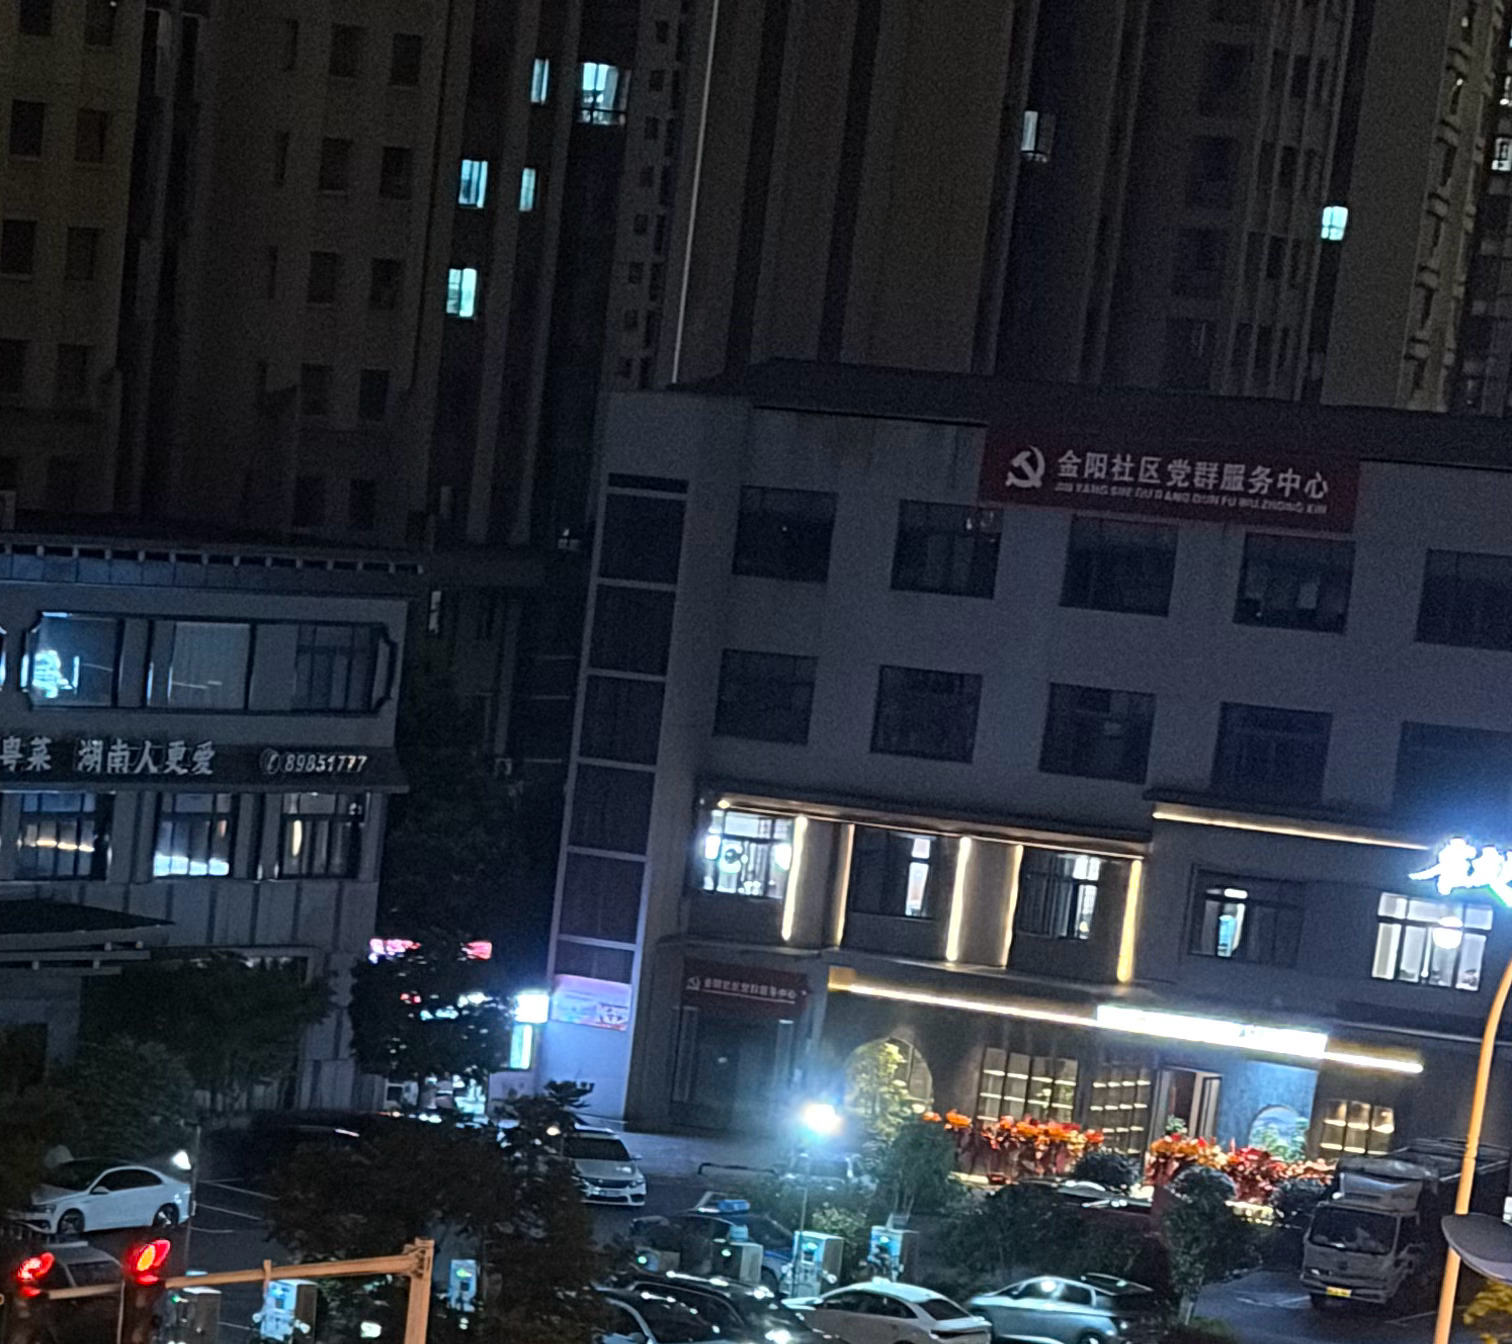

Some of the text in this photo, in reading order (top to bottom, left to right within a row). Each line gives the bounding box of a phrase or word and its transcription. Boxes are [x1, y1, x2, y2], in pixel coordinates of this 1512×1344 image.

[1057, 449, 1328, 499] 金阳社区党群服务中心
[77, 738, 216, 776] 湖南人更爱
